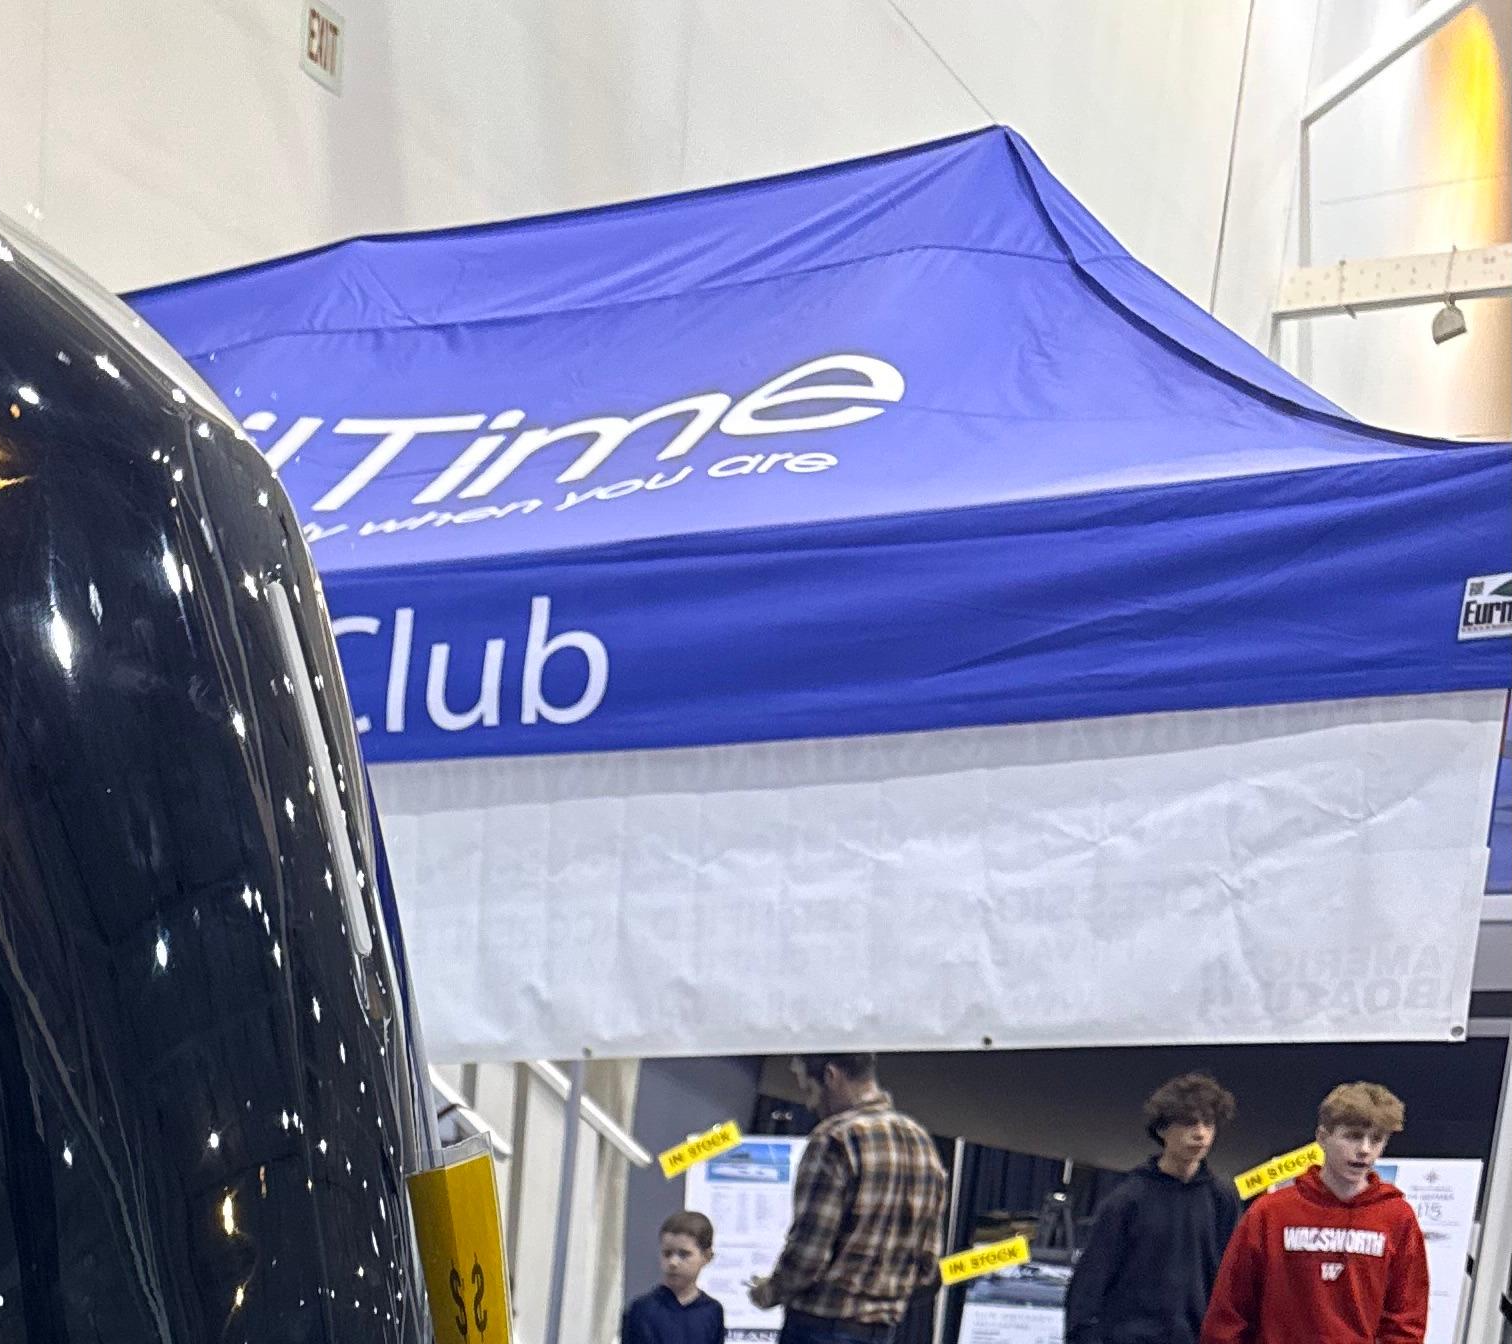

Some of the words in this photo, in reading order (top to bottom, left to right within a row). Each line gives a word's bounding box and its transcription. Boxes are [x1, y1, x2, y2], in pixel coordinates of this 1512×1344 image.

[307, 7, 339, 76] EXIT
[242, 354, 906, 512] lTime
[358, 498, 544, 536] when
[554, 465, 694, 512] you
[706, 451, 839, 478] are
[668, 1152, 684, 1169] IN
[1244, 1173, 1263, 1189] IN
[1267, 1149, 1317, 1180] STOCK
[949, 1260, 966, 1275] IN
[970, 1246, 1020, 1270] STOCK
